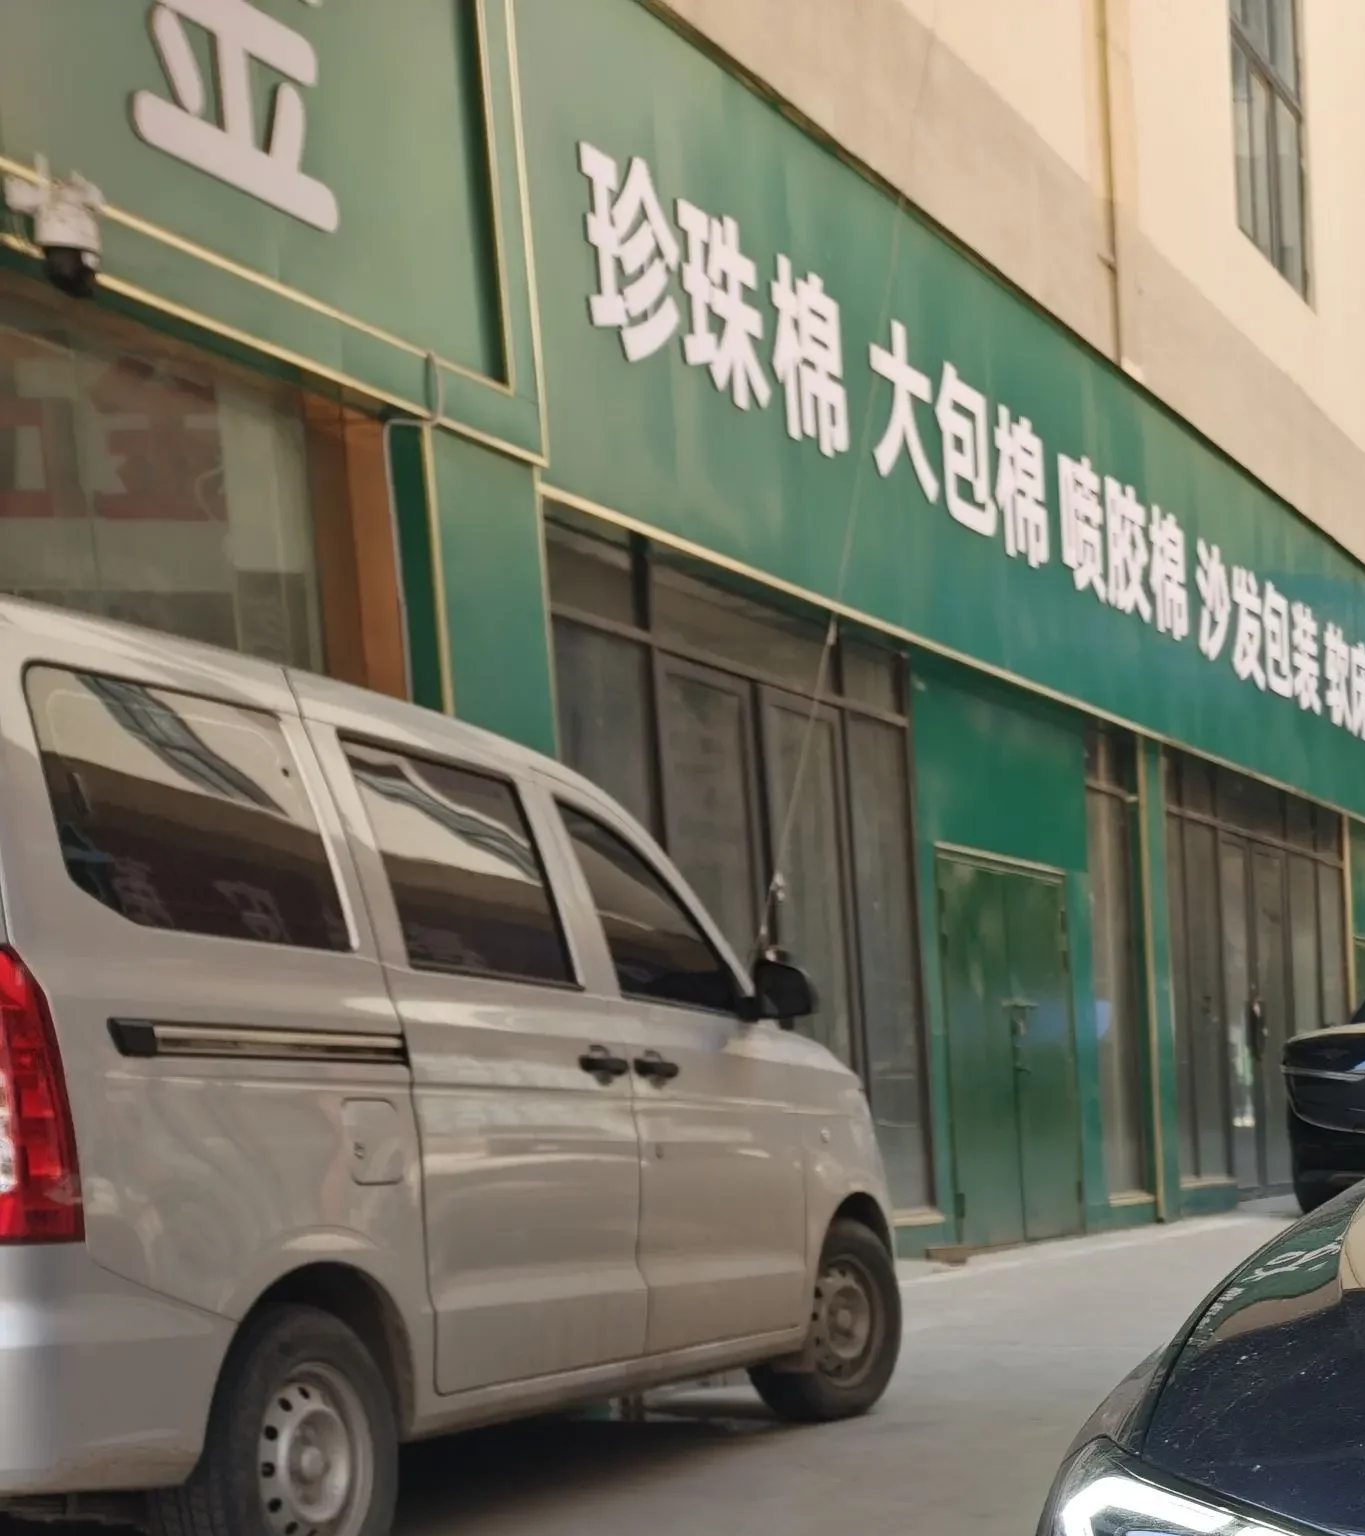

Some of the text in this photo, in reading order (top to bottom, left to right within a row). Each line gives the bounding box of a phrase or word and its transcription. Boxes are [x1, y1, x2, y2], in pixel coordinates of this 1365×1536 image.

[579, 140, 849, 458] 珍珠棉
[869, 318, 1050, 569] 大包棉
[1057, 452, 1189, 642] 喷胶棉
[1195, 537, 1322, 717] 沙发包装
